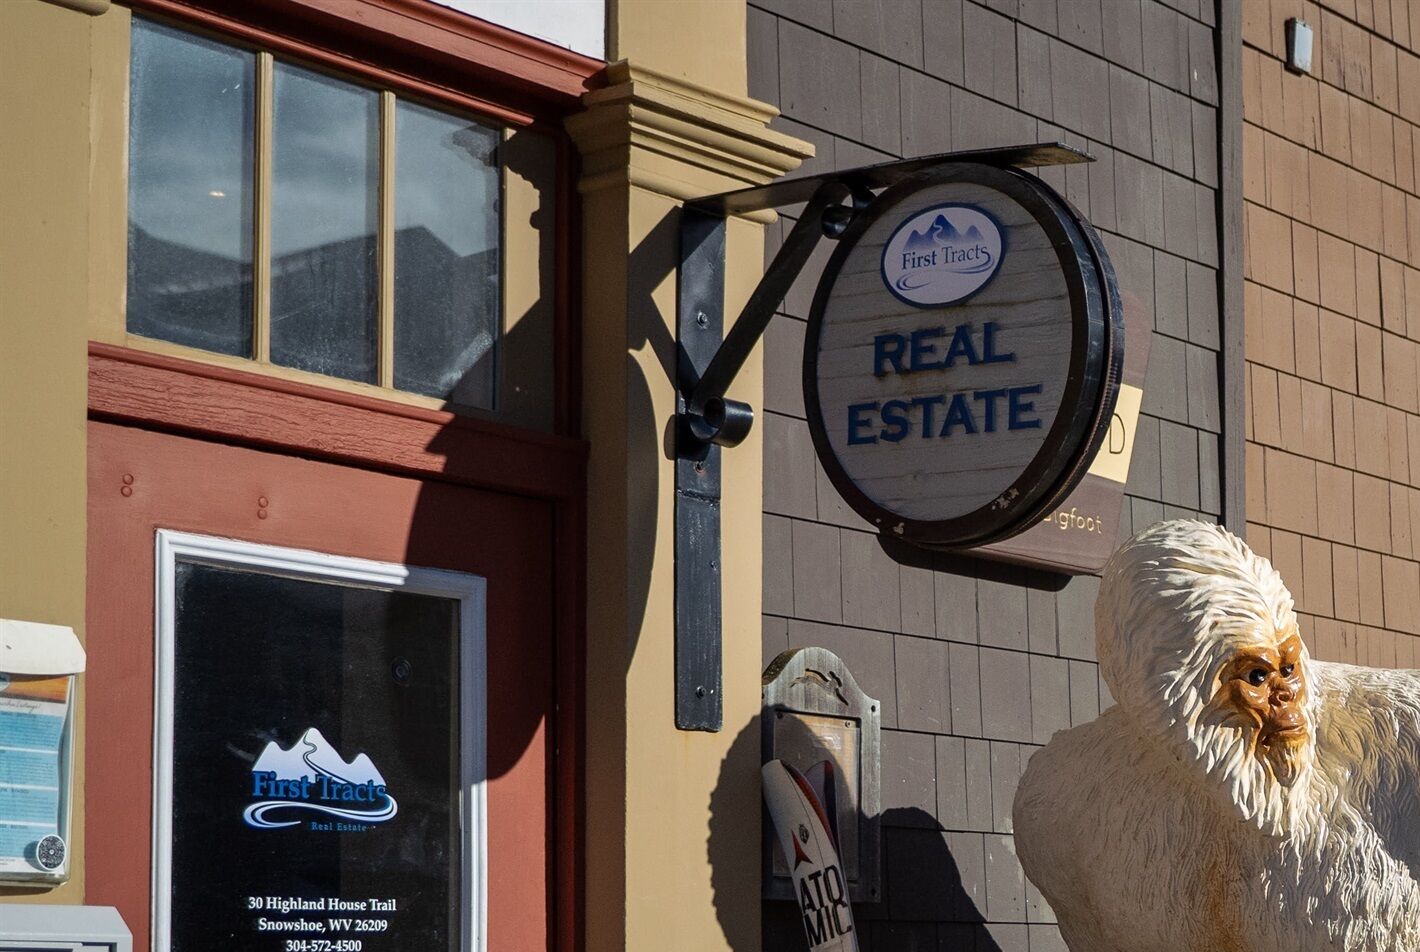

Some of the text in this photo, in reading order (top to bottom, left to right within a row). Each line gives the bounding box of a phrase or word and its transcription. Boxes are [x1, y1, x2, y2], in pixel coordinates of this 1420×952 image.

[901, 244, 992, 270] First Tracts
[873, 321, 1018, 378] REAL
[846, 383, 1045, 447] ESTATE
[252, 770, 387, 802] First Tracts
[311, 821, 367, 832] Real Estate
[248, 896, 397, 913] 30 Highland House Trail
[258, 917, 388, 933] Snowshoe, WV 26209
[285, 939, 362, 952] 304-572-4500
